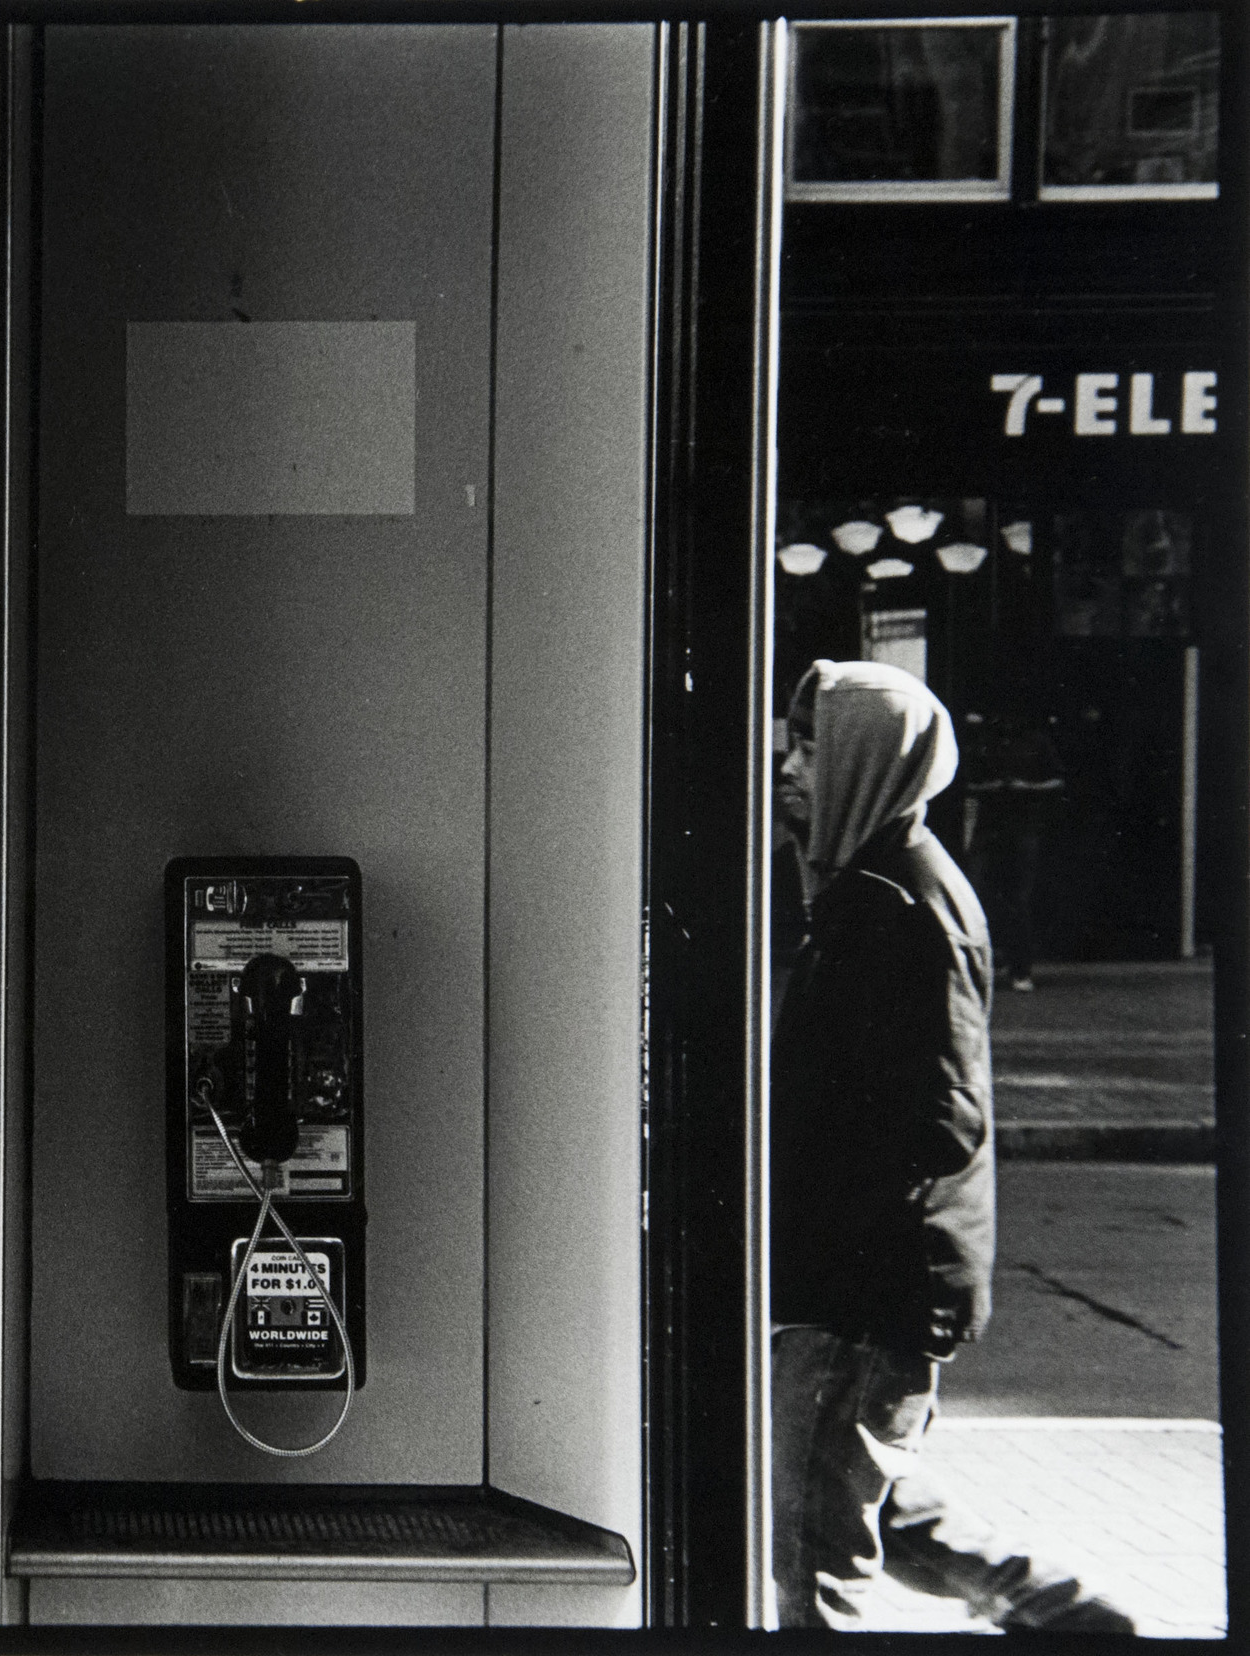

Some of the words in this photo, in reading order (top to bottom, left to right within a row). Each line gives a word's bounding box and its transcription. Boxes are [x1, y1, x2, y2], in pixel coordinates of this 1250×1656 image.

[990, 370, 1217, 436] 7-ELE
[250, 1263, 259, 1273] 4
[261, 1263, 326, 1274] MINUTS
[251, 1278, 281, 1289] FOR
[249, 1330, 329, 1340] WORLDWIDE
